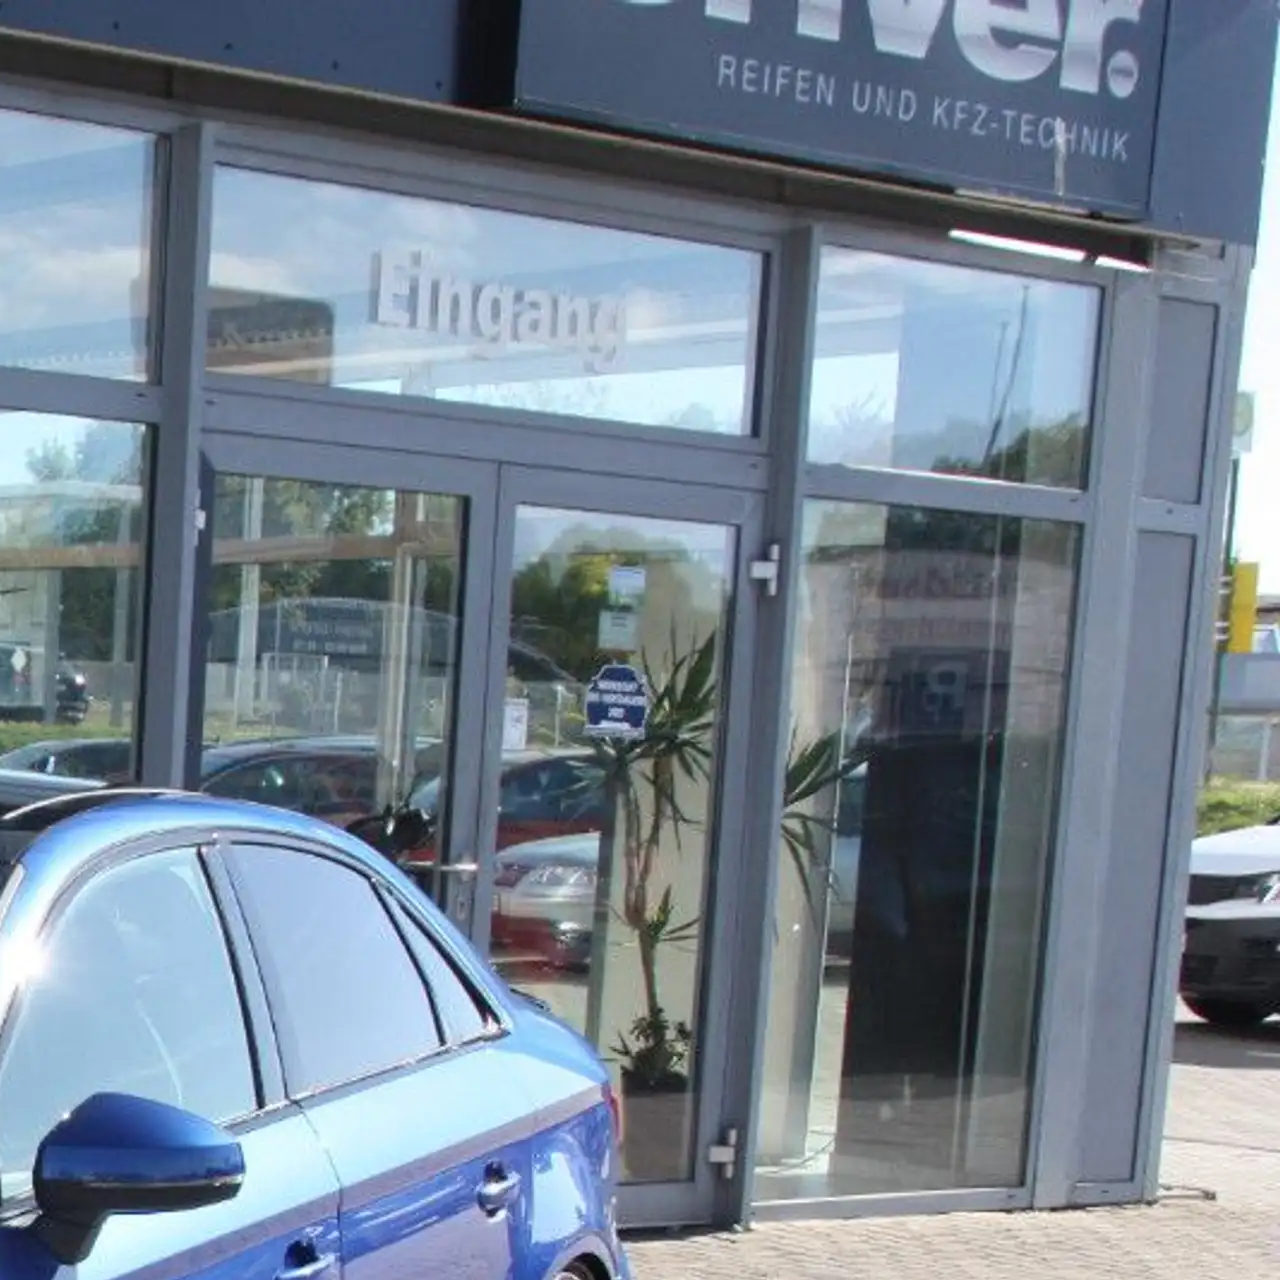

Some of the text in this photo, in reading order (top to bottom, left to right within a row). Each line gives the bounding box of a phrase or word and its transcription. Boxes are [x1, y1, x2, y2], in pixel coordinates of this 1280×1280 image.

[717, 54, 1130, 161] REIFEN UND KFZ-TECHNIK
[368, 247, 627, 373] Eingang
